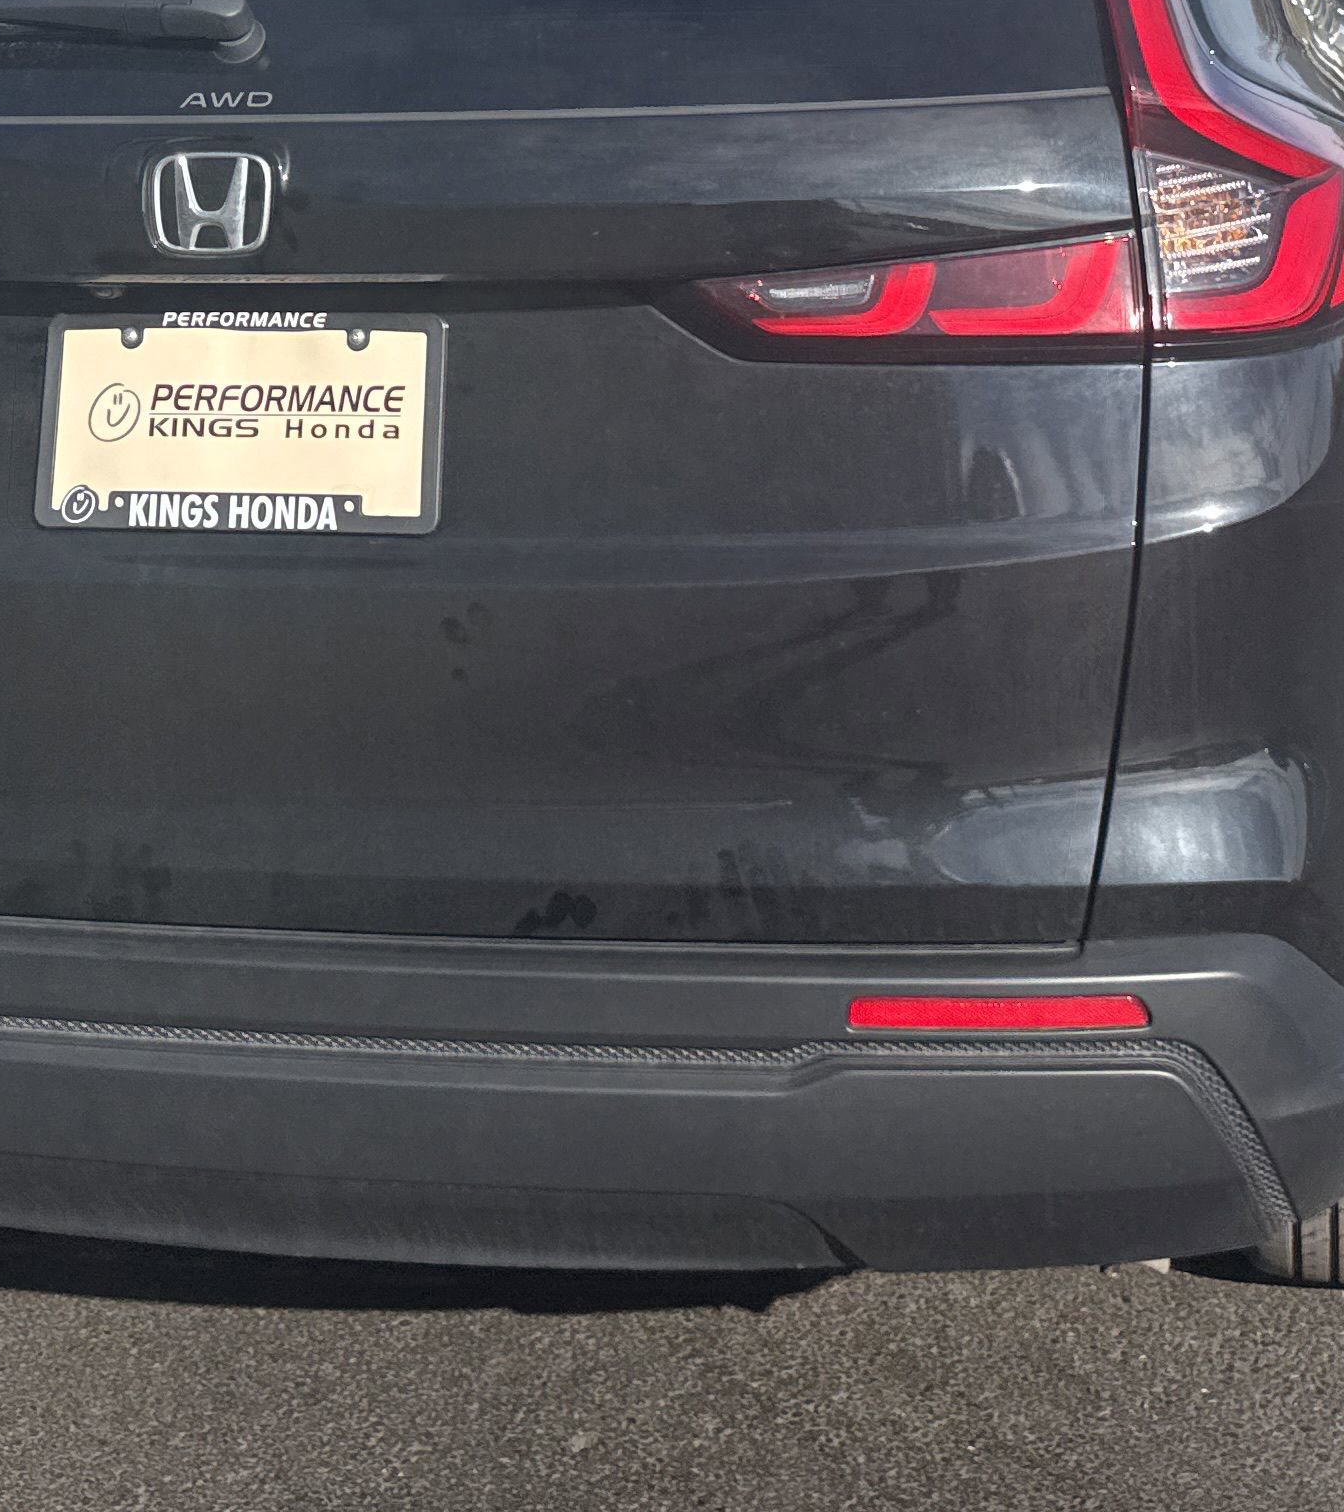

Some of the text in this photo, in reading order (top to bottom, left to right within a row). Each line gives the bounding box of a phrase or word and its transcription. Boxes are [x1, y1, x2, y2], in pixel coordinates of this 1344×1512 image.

[179, 91, 273, 109] AWD
[162, 311, 328, 328] PERFORMANCE
[149, 383, 406, 413] PERFORMANCE
[148, 417, 401, 439] KINGS Honda
[128, 493, 338, 531] KINGS HONDA
